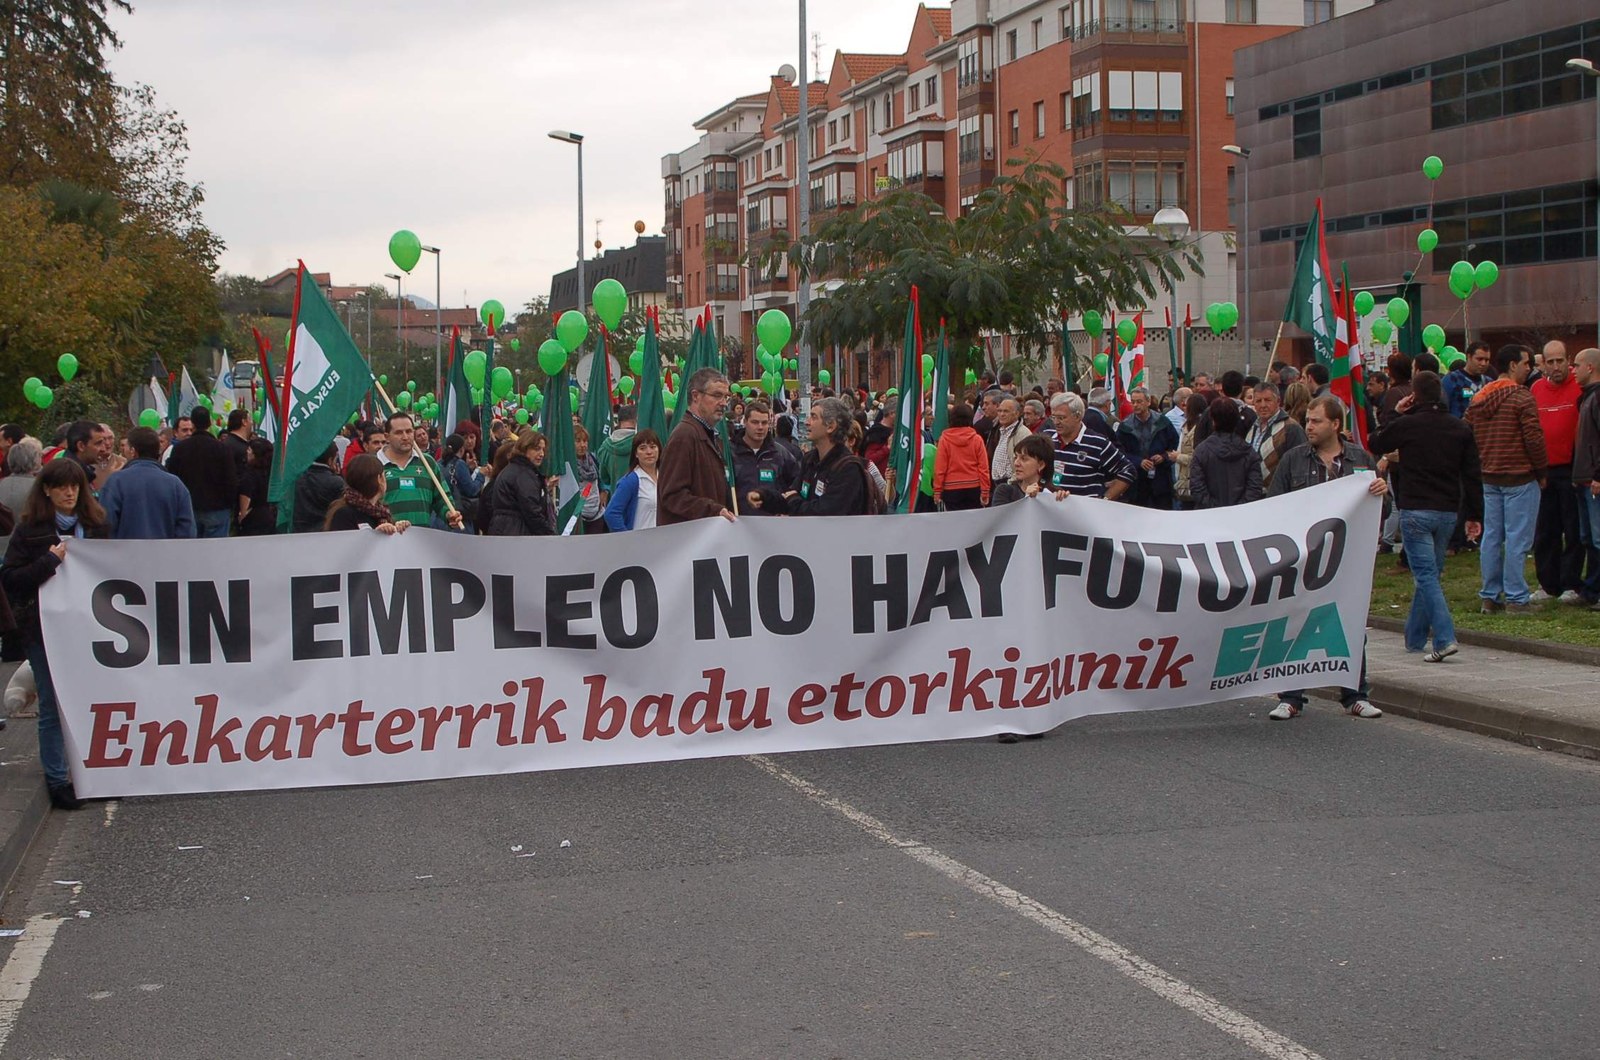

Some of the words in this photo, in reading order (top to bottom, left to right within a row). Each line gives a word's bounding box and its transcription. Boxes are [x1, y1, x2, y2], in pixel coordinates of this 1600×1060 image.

[91, 578, 252, 669] SIN
[290, 565, 659, 661] EMPLEO
[692, 554, 816, 641] NO
[851, 534, 1019, 634] HAY
[1041, 517, 1347, 613] FUTURO
[1212, 602, 1351, 678] ELA
[83, 676, 567, 769] Enkarterrik
[582, 667, 773, 742] badu
[787, 635, 1195, 725] etorkizunik
[1209, 671, 1260, 691] EUSKAL
[1263, 659, 1350, 680] SINDIKATUA
